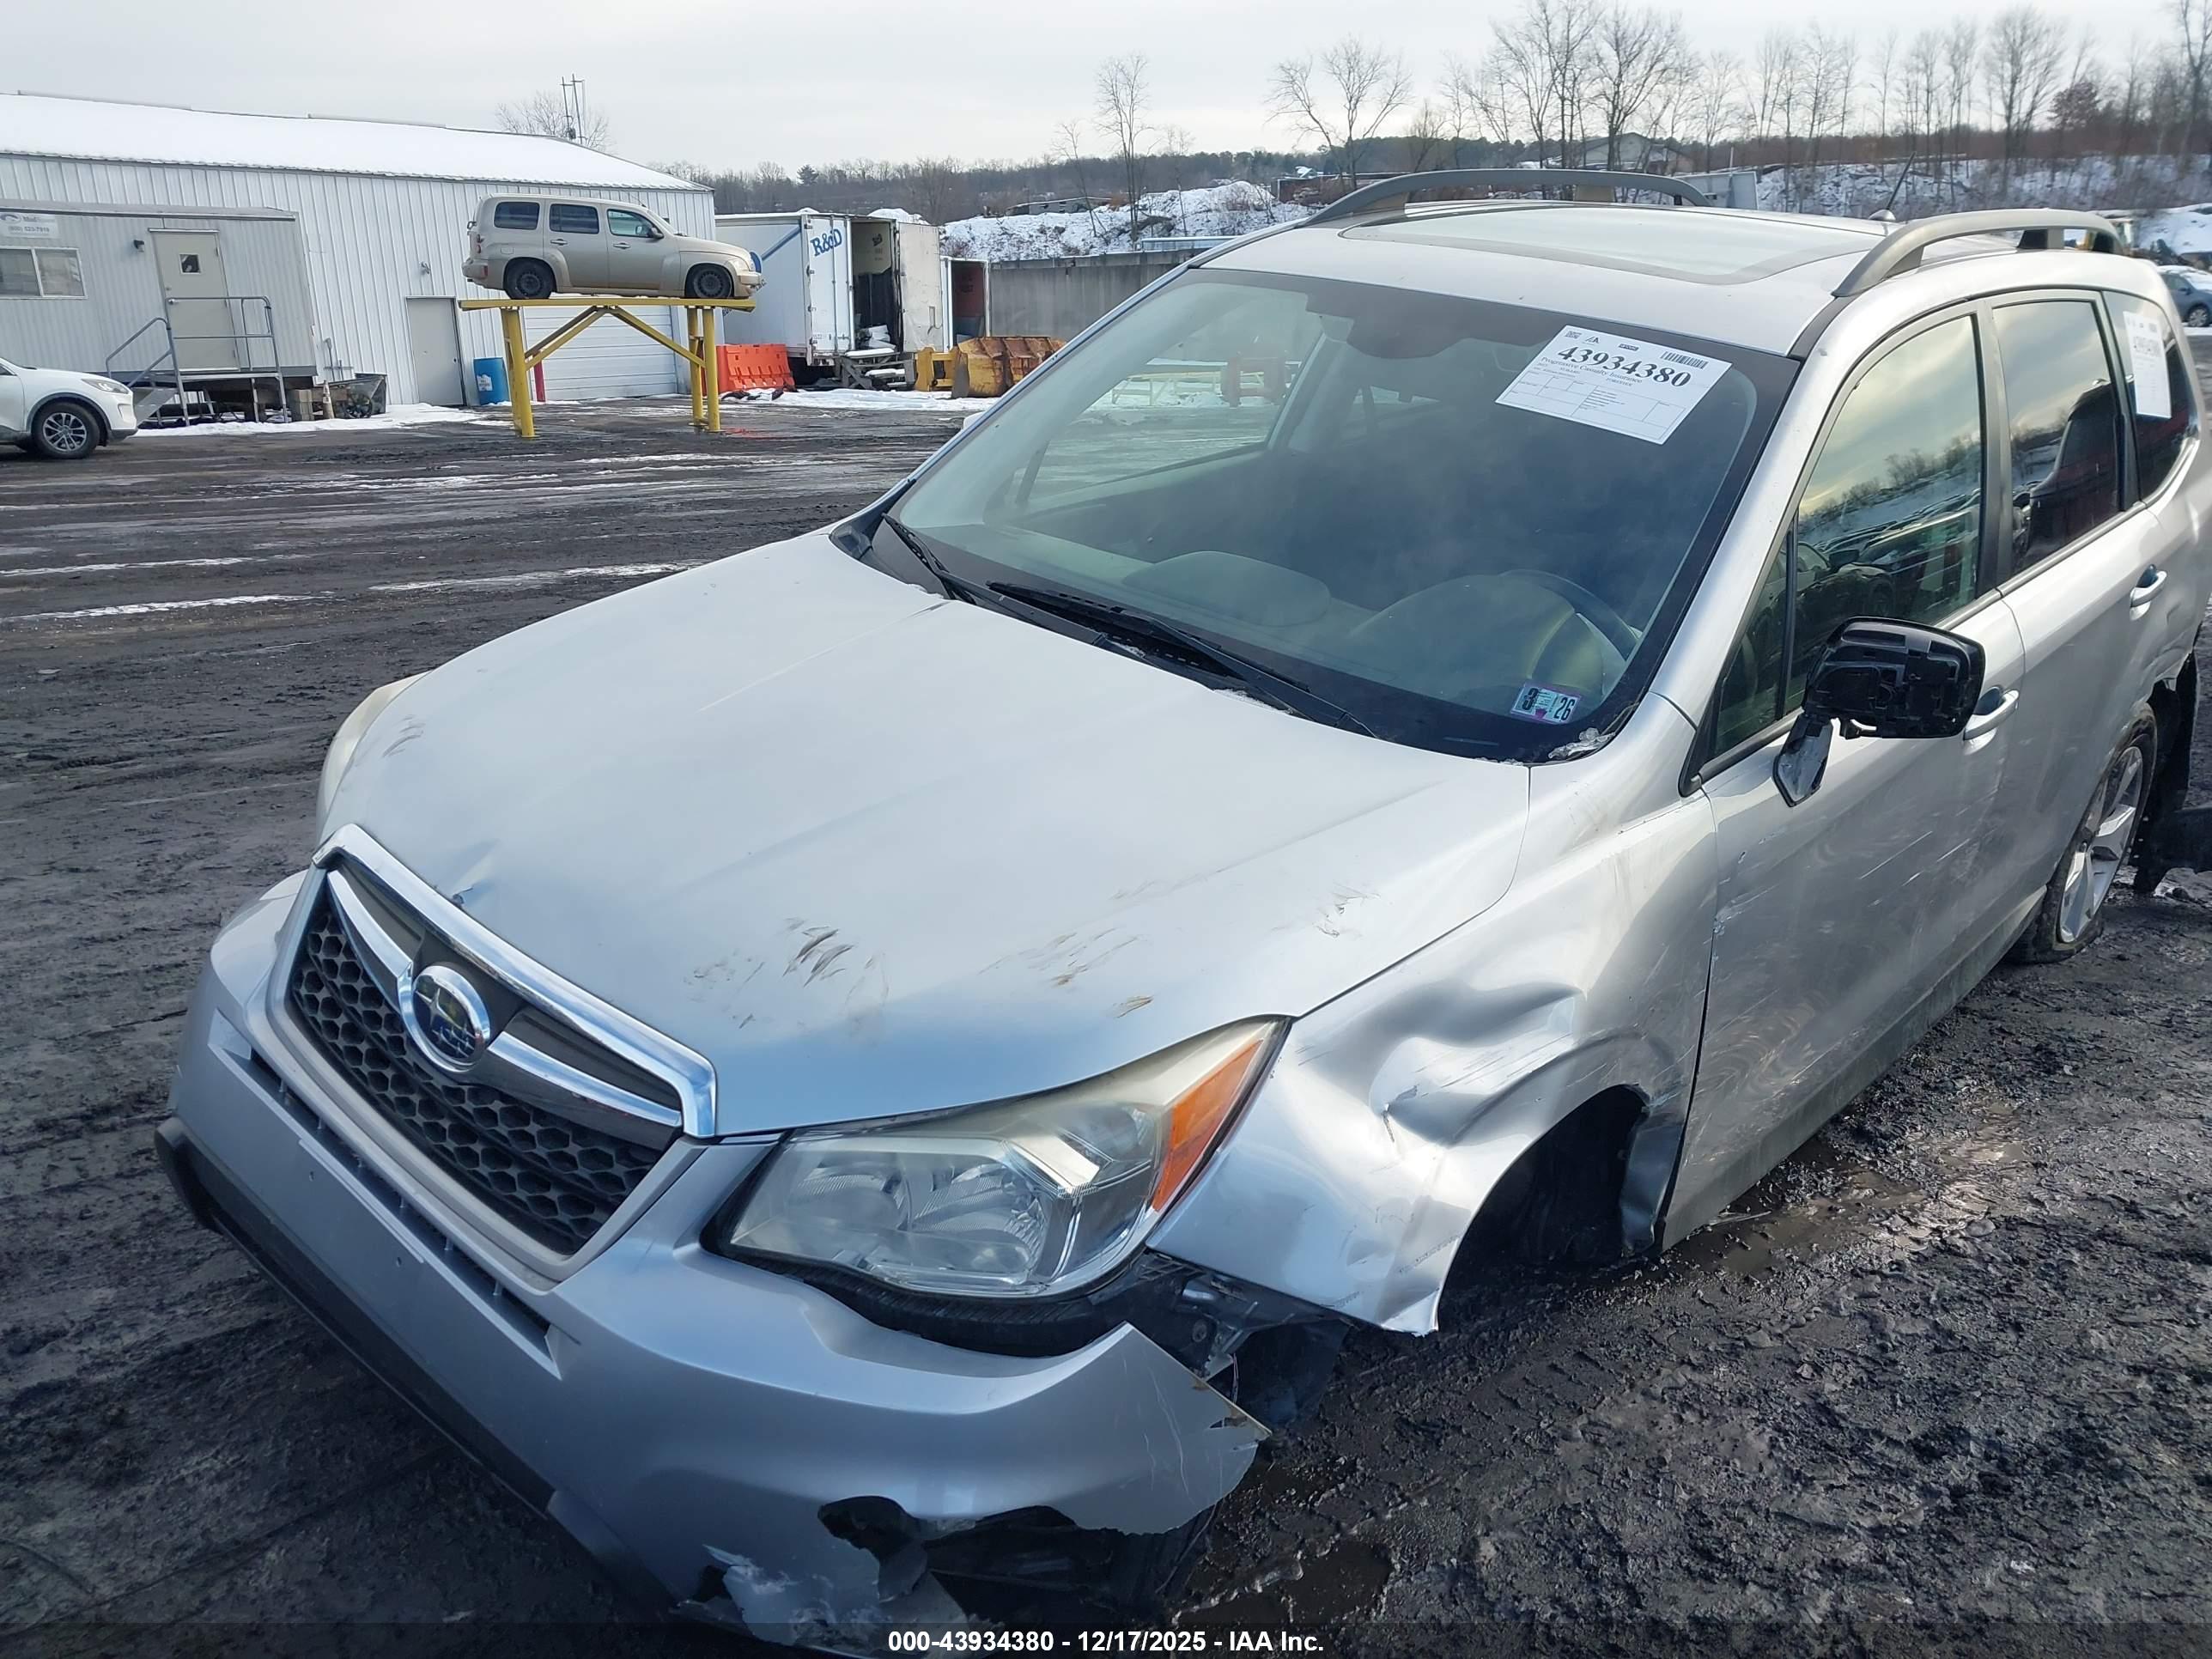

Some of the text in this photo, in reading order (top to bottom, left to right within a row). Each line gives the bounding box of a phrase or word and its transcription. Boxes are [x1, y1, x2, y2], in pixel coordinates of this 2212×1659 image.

[1541, 356, 1579, 368] Progressive
[1579, 365, 1608, 376] Casualty
[1609, 372, 1643, 384] Insurance
[1558, 345, 1692, 388] 43934380
[1553, 696, 1577, 721] 26
